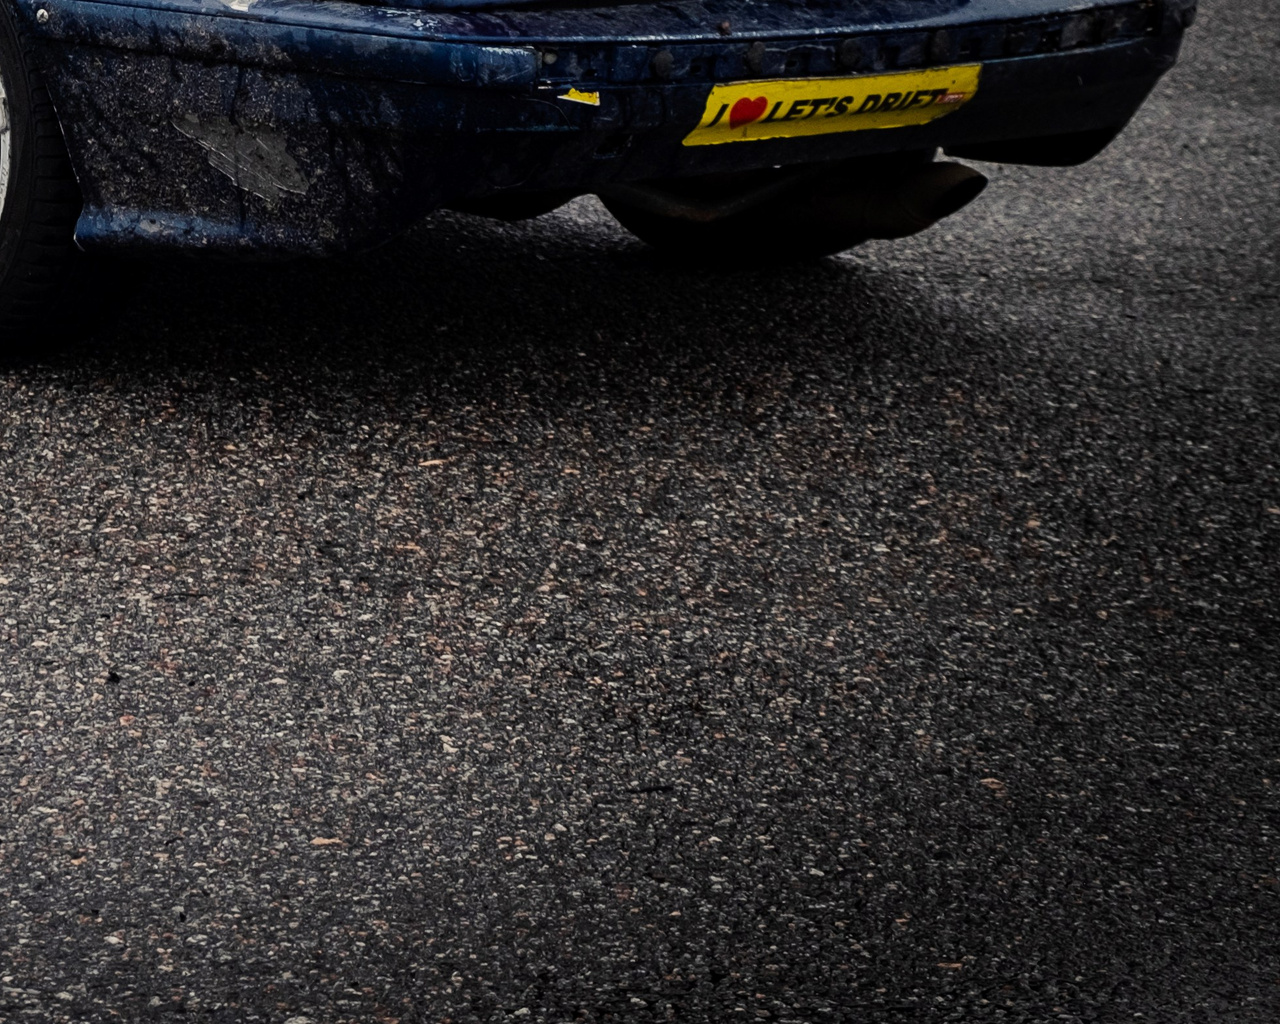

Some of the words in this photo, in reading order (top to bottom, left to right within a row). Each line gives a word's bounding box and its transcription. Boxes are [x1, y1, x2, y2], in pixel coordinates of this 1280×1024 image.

[707, 103, 729, 128] I
[758, 95, 853, 123] LET'S
[853, 87, 950, 116] DRIFT
